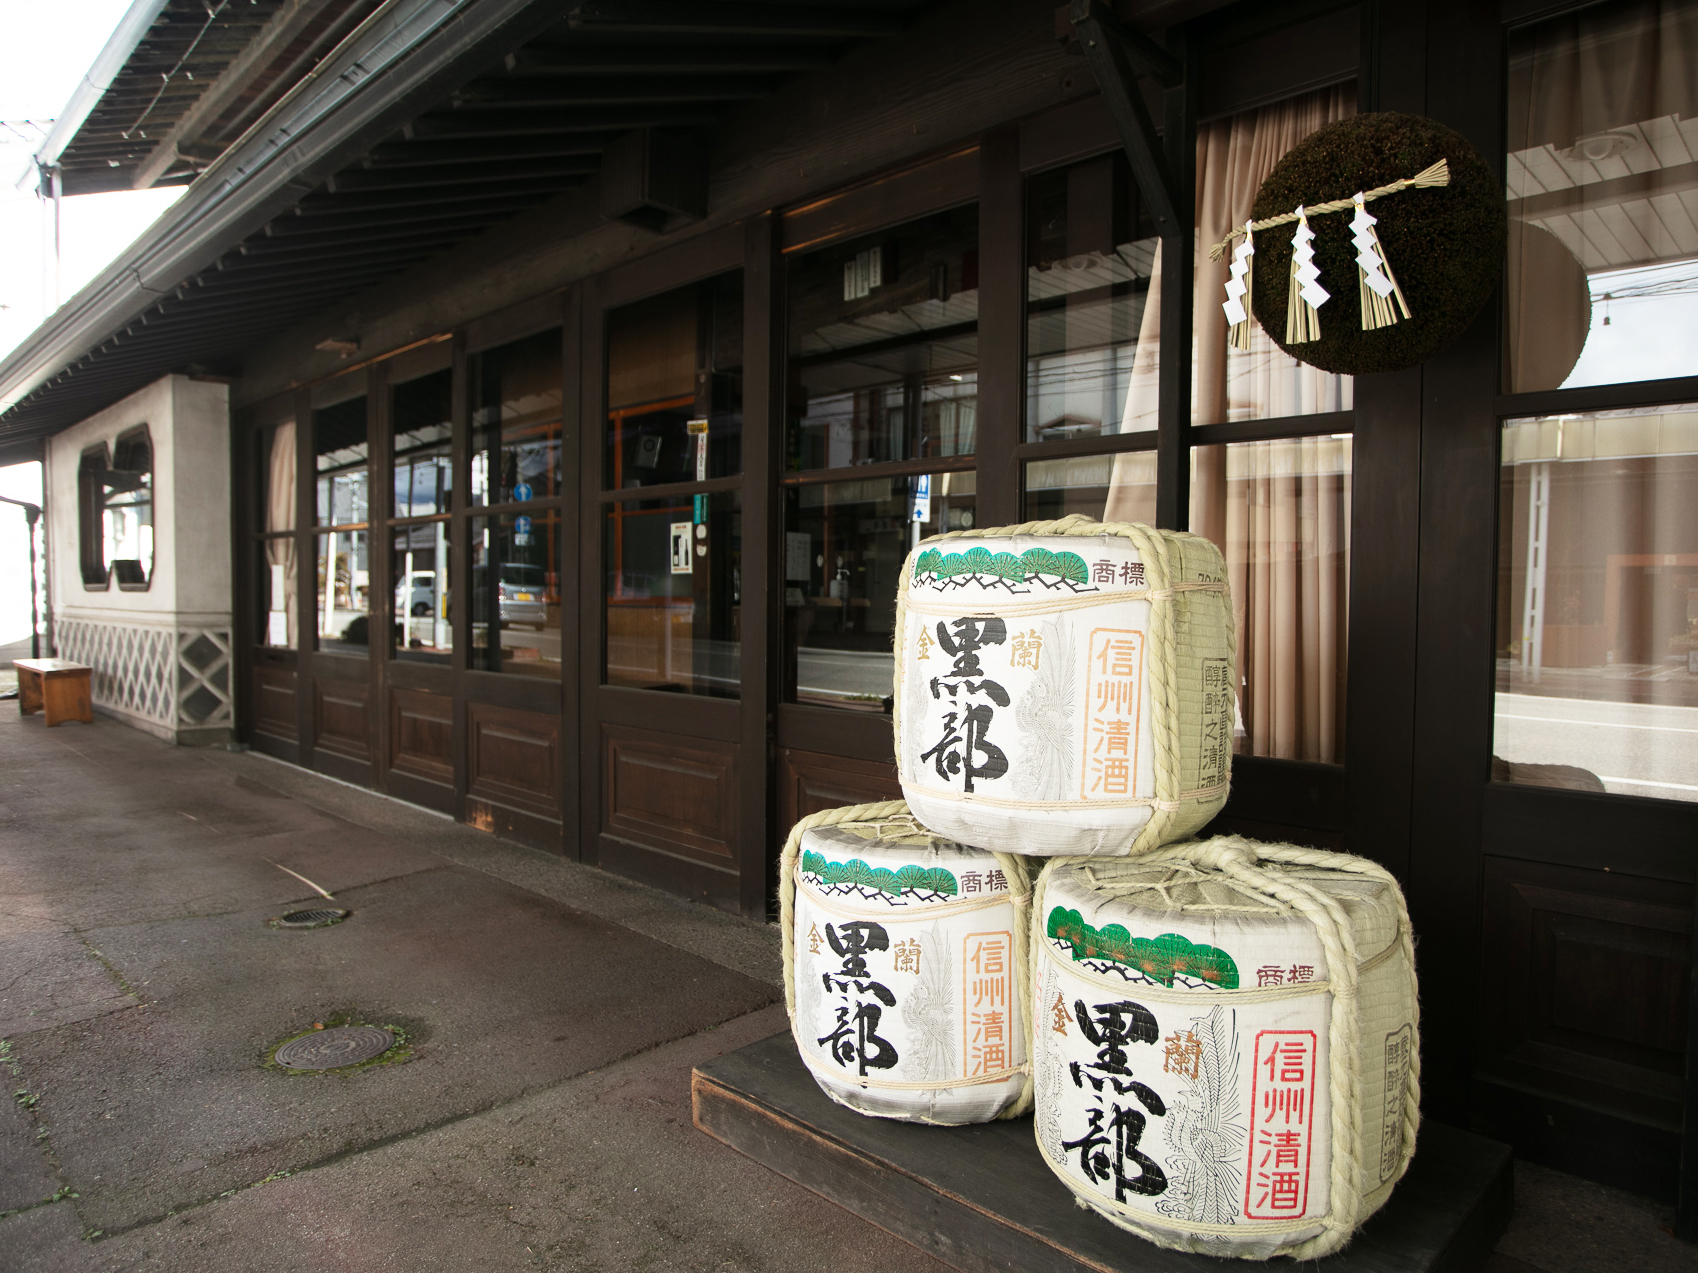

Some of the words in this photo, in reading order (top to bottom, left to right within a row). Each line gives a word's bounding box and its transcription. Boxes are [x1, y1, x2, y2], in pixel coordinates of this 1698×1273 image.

[1092, 560, 1145, 586] 商標
[916, 625, 936, 661] 金
[1010, 629, 1043, 671] 蘭
[920, 612, 1011, 793] 黒部
[1090, 638, 1136, 794] 信州清酒
[960, 869, 1008, 893] 商標
[807, 921, 825, 955] 金
[893, 938, 922, 975] 蘭
[1256, 963, 1316, 987] 商標
[818, 920, 899, 1089] 黒部
[970, 940, 1005, 1076] 信州清酒
[1051, 992, 1074, 1037] 金
[1163, 1031, 1202, 1080] 蘭
[1062, 999, 1169, 1205] 黒部
[1256, 1040, 1308, 1211] 信州清酒
